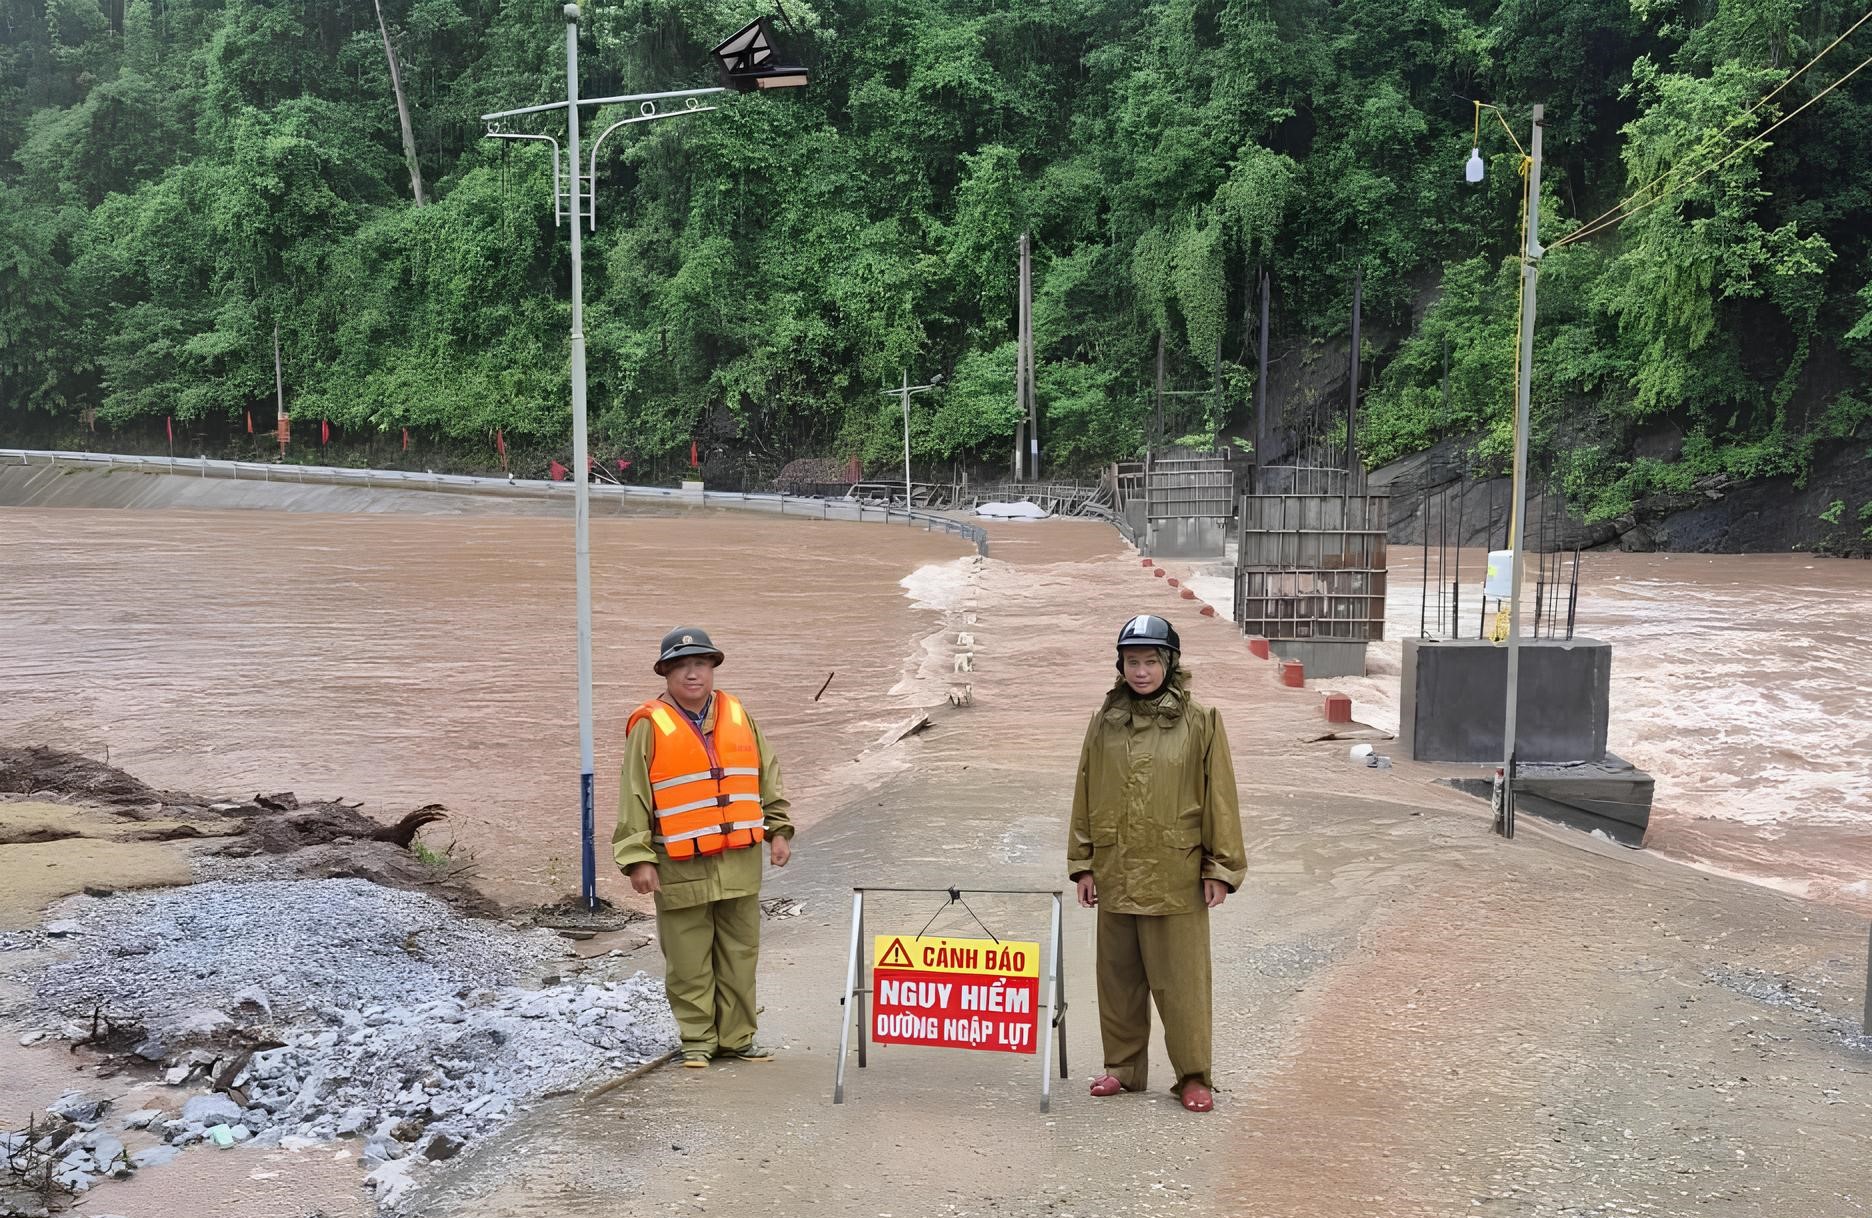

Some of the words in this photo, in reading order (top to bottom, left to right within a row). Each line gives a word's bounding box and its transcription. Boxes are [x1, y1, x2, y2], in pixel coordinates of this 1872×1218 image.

[922, 941, 978, 969] CẢNH
[985, 946, 1025, 972] BÁO
[880, 980, 952, 1008] NGUY
[961, 977, 1029, 1014] HIỂM
[943, 1016, 992, 1046] NGẬP
[998, 1022, 1032, 1049] LỤT
